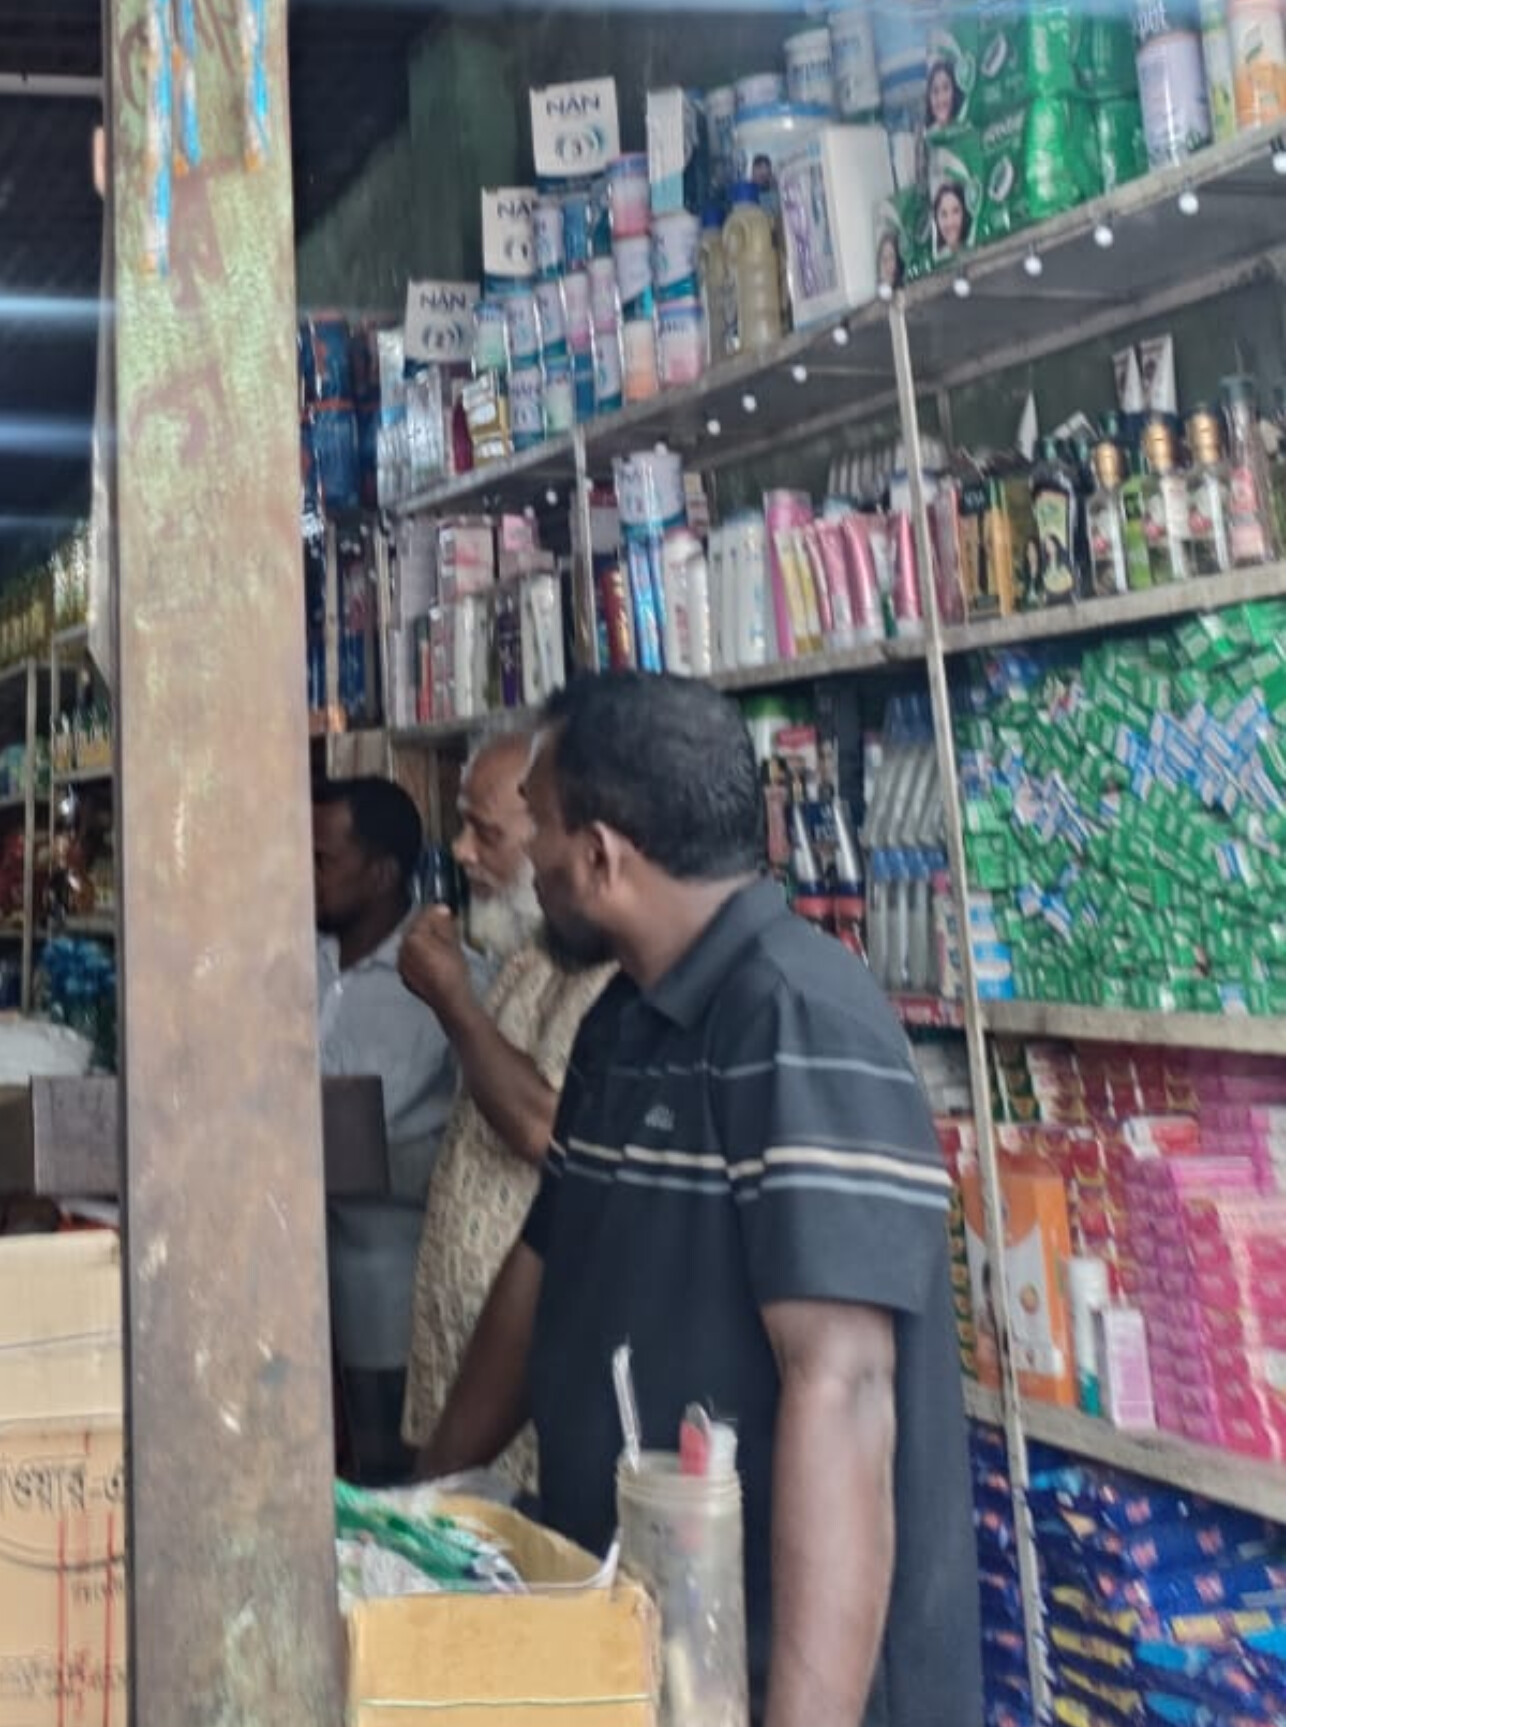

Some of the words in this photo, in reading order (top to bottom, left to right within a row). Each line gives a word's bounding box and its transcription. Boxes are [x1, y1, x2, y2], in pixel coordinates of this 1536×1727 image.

[545, 95, 600, 116] NAN
[496, 199, 540, 219] NA
[419, 290, 466, 312] NAN
